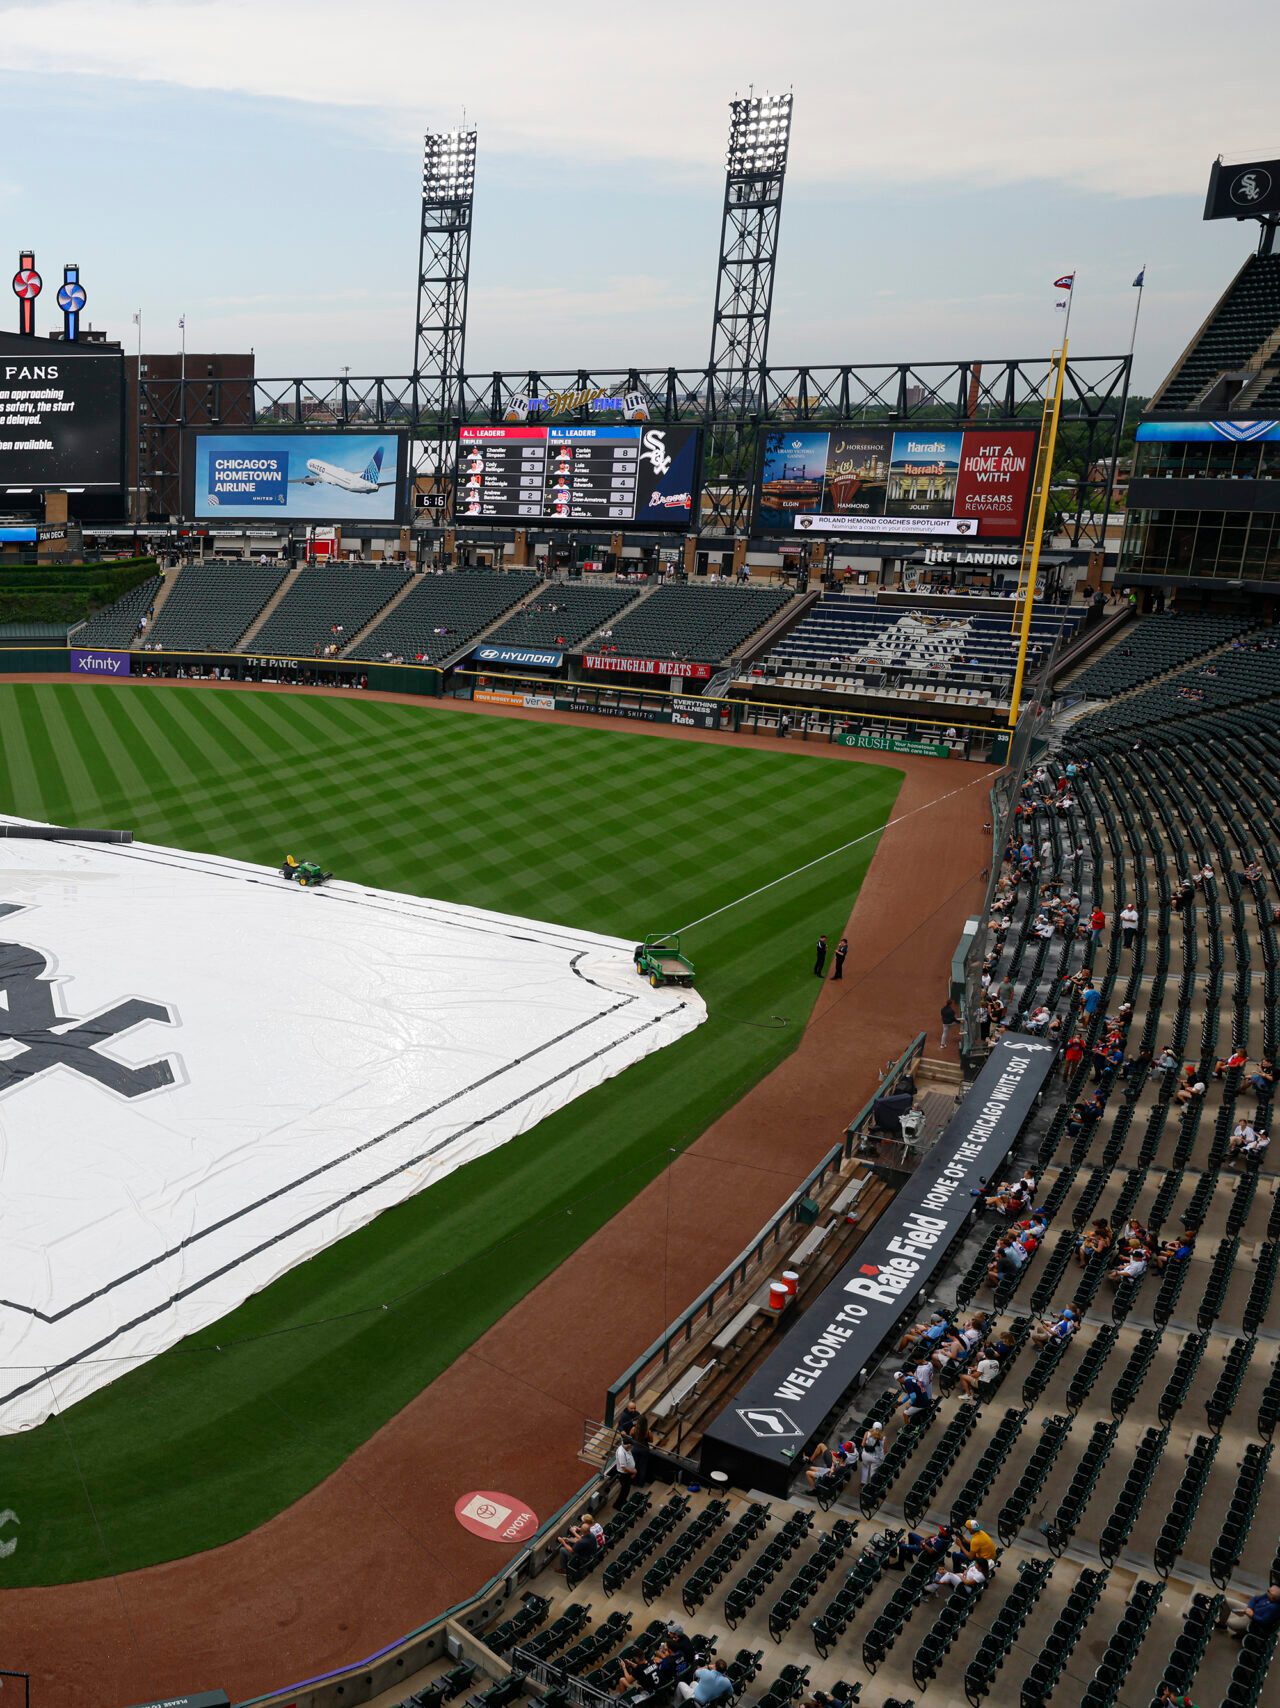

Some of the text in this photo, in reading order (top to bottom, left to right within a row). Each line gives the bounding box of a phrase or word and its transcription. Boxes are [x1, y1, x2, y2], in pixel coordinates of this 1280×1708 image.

[6, 366, 59, 380] FANS
[0, 390, 10, 399] an
[11, 388, 64, 401] approaching
[5, 401, 35, 413] safety,
[37, 401, 52, 412] the
[52, 401, 75, 412] start
[545, 387, 608, 417] Miller
[593, 398, 623, 411] TIME
[6, 414, 42, 426] delayed.
[14, 440, 54, 450] available.
[979, 446, 1014, 456] HIT A
[215, 459, 278, 470] CHICAGO'S
[964, 457, 1026, 472] HOME RUN
[215, 471, 282, 482] HOMETOWN
[976, 472, 1010, 482] WITH
[215, 482, 256, 493] AIRLINE
[965, 494, 1013, 503] CAESARS
[39, 530, 65, 540] FAN DECK
[957, 552, 1018, 566] LANDING
[78, 655, 121, 672] xfinity
[246, 657, 267, 667] THE
[501, 652, 555, 664] HYUNDAI
[586, 656, 655, 673] WHITTINGHAM
[658, 663, 692, 677] MEATS
[525, 697, 553, 707] verve
[673, 699, 718, 709] EVERYTHING
[673, 704, 711, 713] WELLNESS
[672, 713, 695, 725] Rate
[858, 736, 890, 750] RUSH
[997, 734, 1009, 742] 335
[773, 1056, 1031, 1402] WELCOME TO Rate Field HOME OF THE CHICAGO WHITE SOX
[502, 1512, 532, 1539] TOYOTA
[651, 1672, 660, 1684] 5
